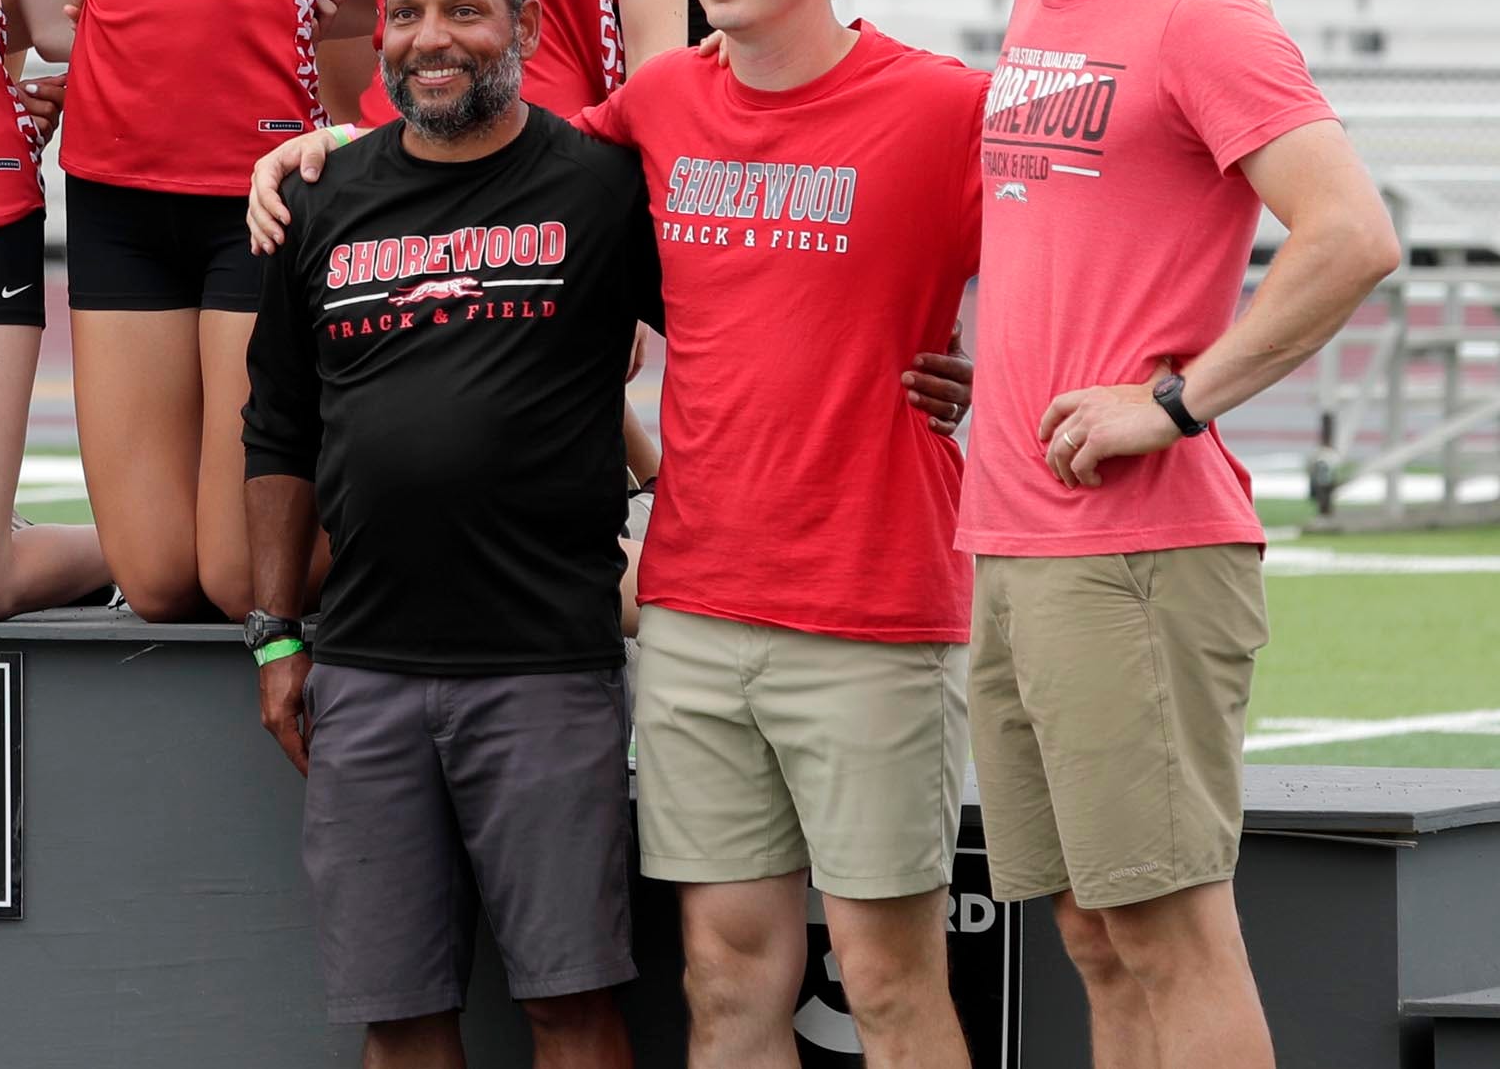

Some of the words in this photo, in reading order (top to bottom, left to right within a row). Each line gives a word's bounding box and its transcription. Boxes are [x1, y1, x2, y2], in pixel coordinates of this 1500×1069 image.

[1020, 48, 1043, 67] STATE
[1042, 50, 1087, 70] QUALIFIER
[985, 65, 1116, 142] HOREWOOD
[1020, 154, 1049, 180] FIELD
[666, 156, 857, 225] SHOREWOOD
[326, 221, 567, 289] SHOREWOOD
[662, 222, 729, 246] TRACK
[744, 229, 756, 247] &
[771, 230, 849, 253] FIELD
[328, 312, 414, 340] TRACK
[433, 308, 449, 324] &
[466, 300, 557, 321] FIELD
